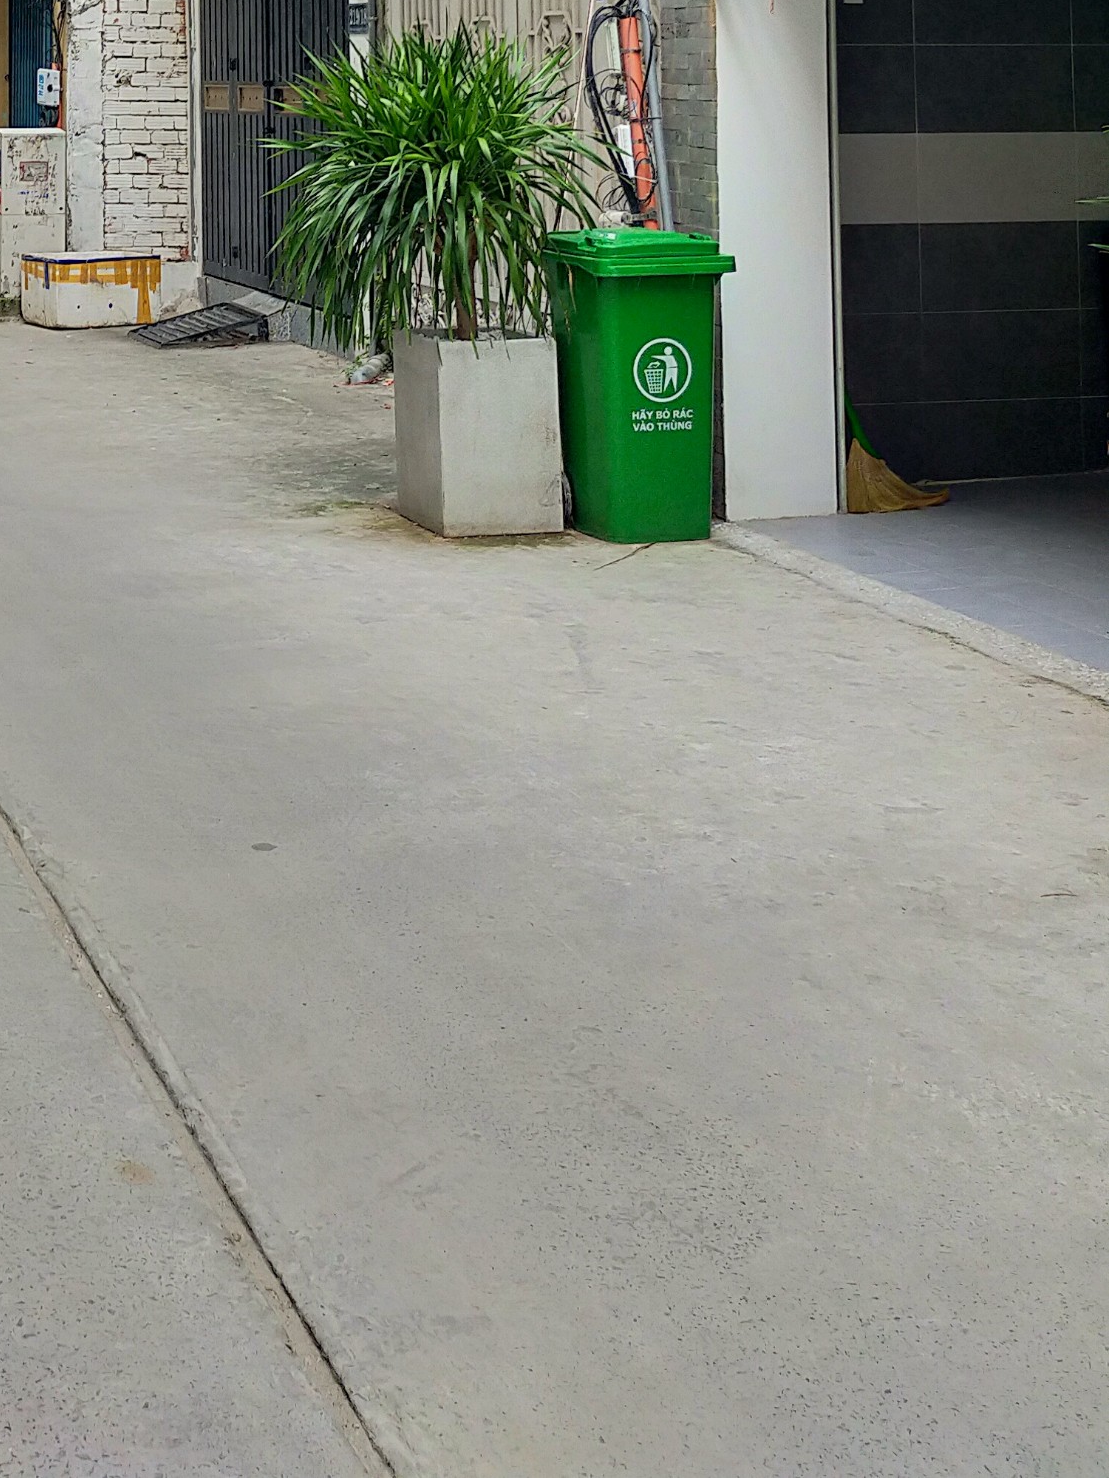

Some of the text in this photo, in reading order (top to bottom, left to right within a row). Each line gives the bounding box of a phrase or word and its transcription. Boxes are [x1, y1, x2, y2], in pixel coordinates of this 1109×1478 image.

[632, 407, 694, 420] HÃY BỎ RÁC
[632, 420, 692, 432] VÀO THÙNG
